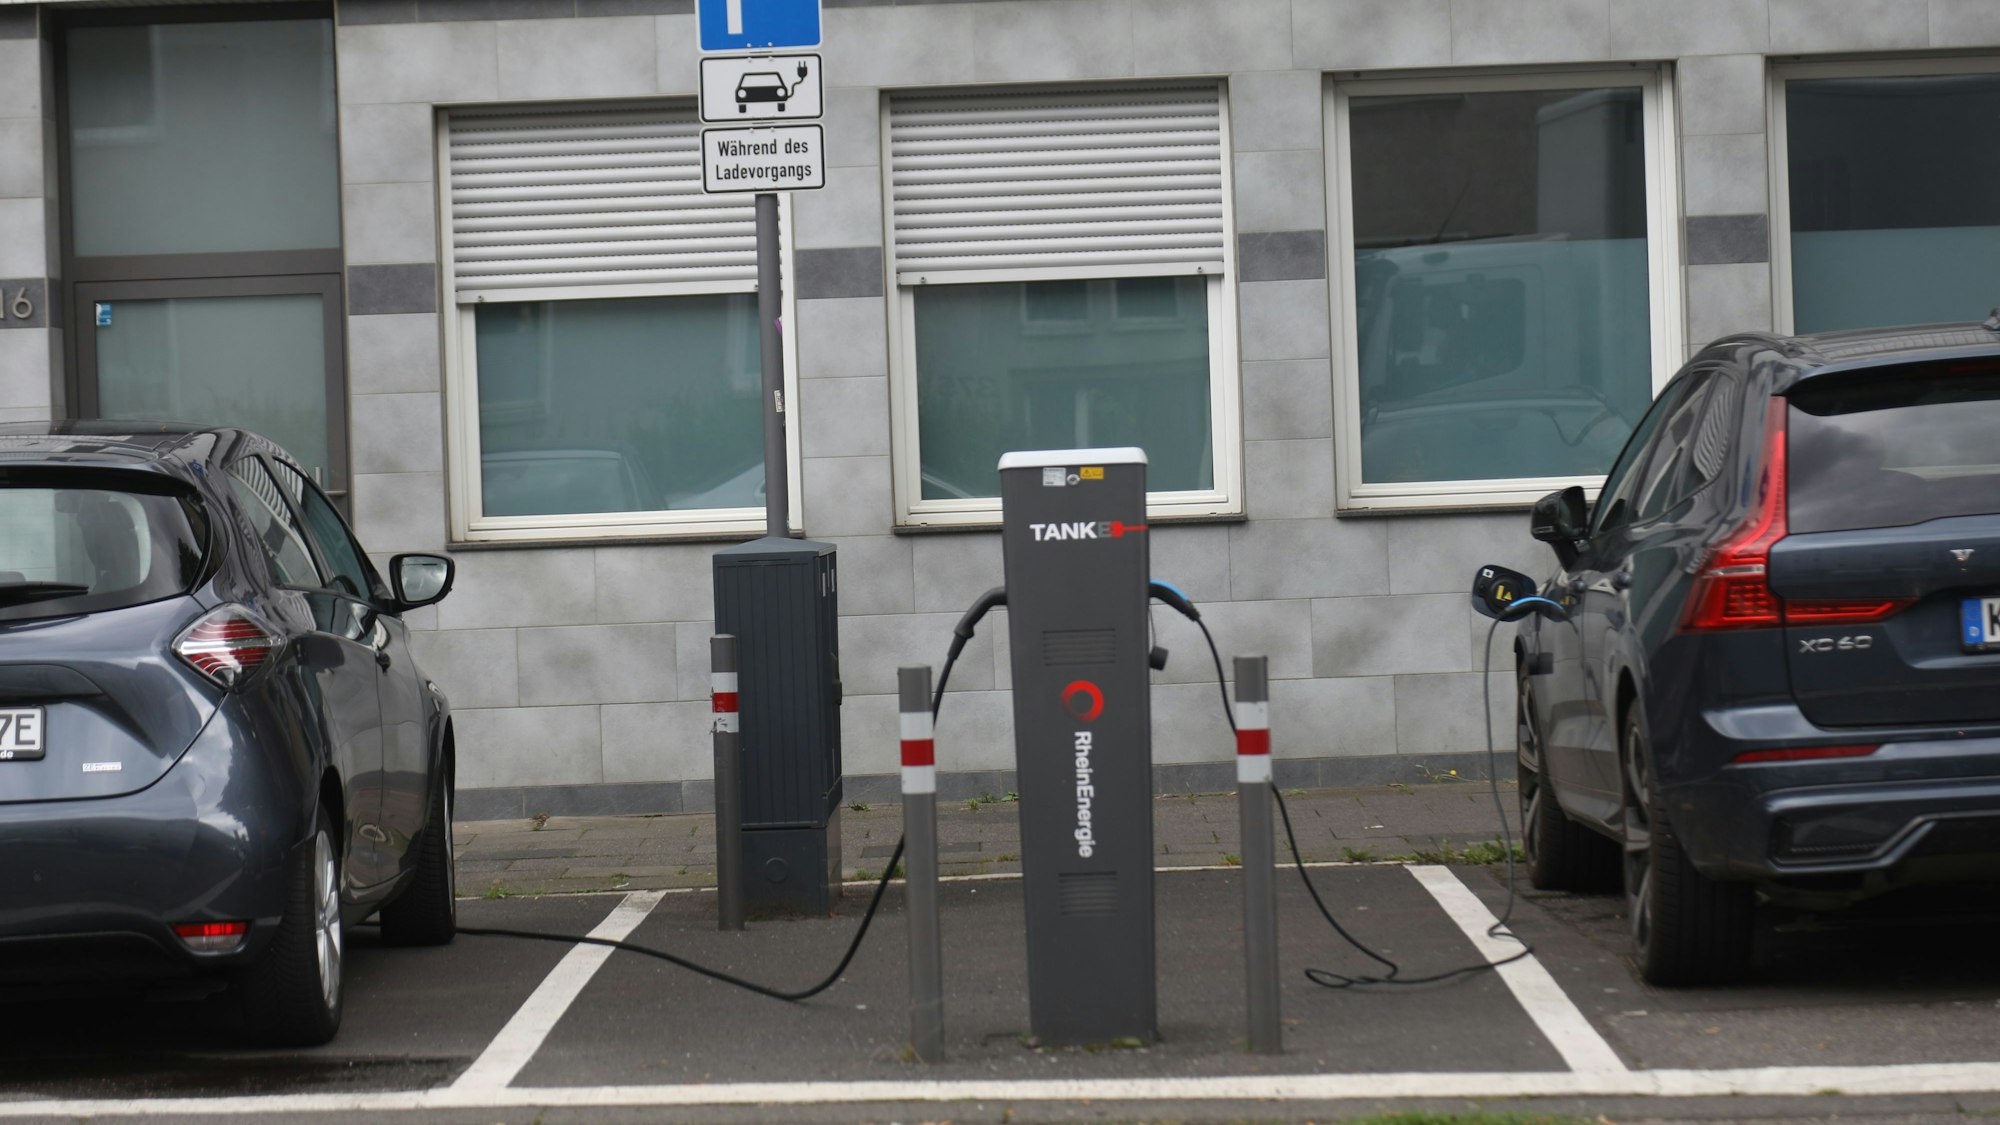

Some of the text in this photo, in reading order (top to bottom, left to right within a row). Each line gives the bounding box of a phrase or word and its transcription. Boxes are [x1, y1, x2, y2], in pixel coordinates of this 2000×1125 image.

[717, 138, 809, 157] Während des
[716, 163, 812, 182] Ladevorgangs
[1799, 635, 1873, 654] XC60
[1074, 731, 1096, 859] RheinEnergie
